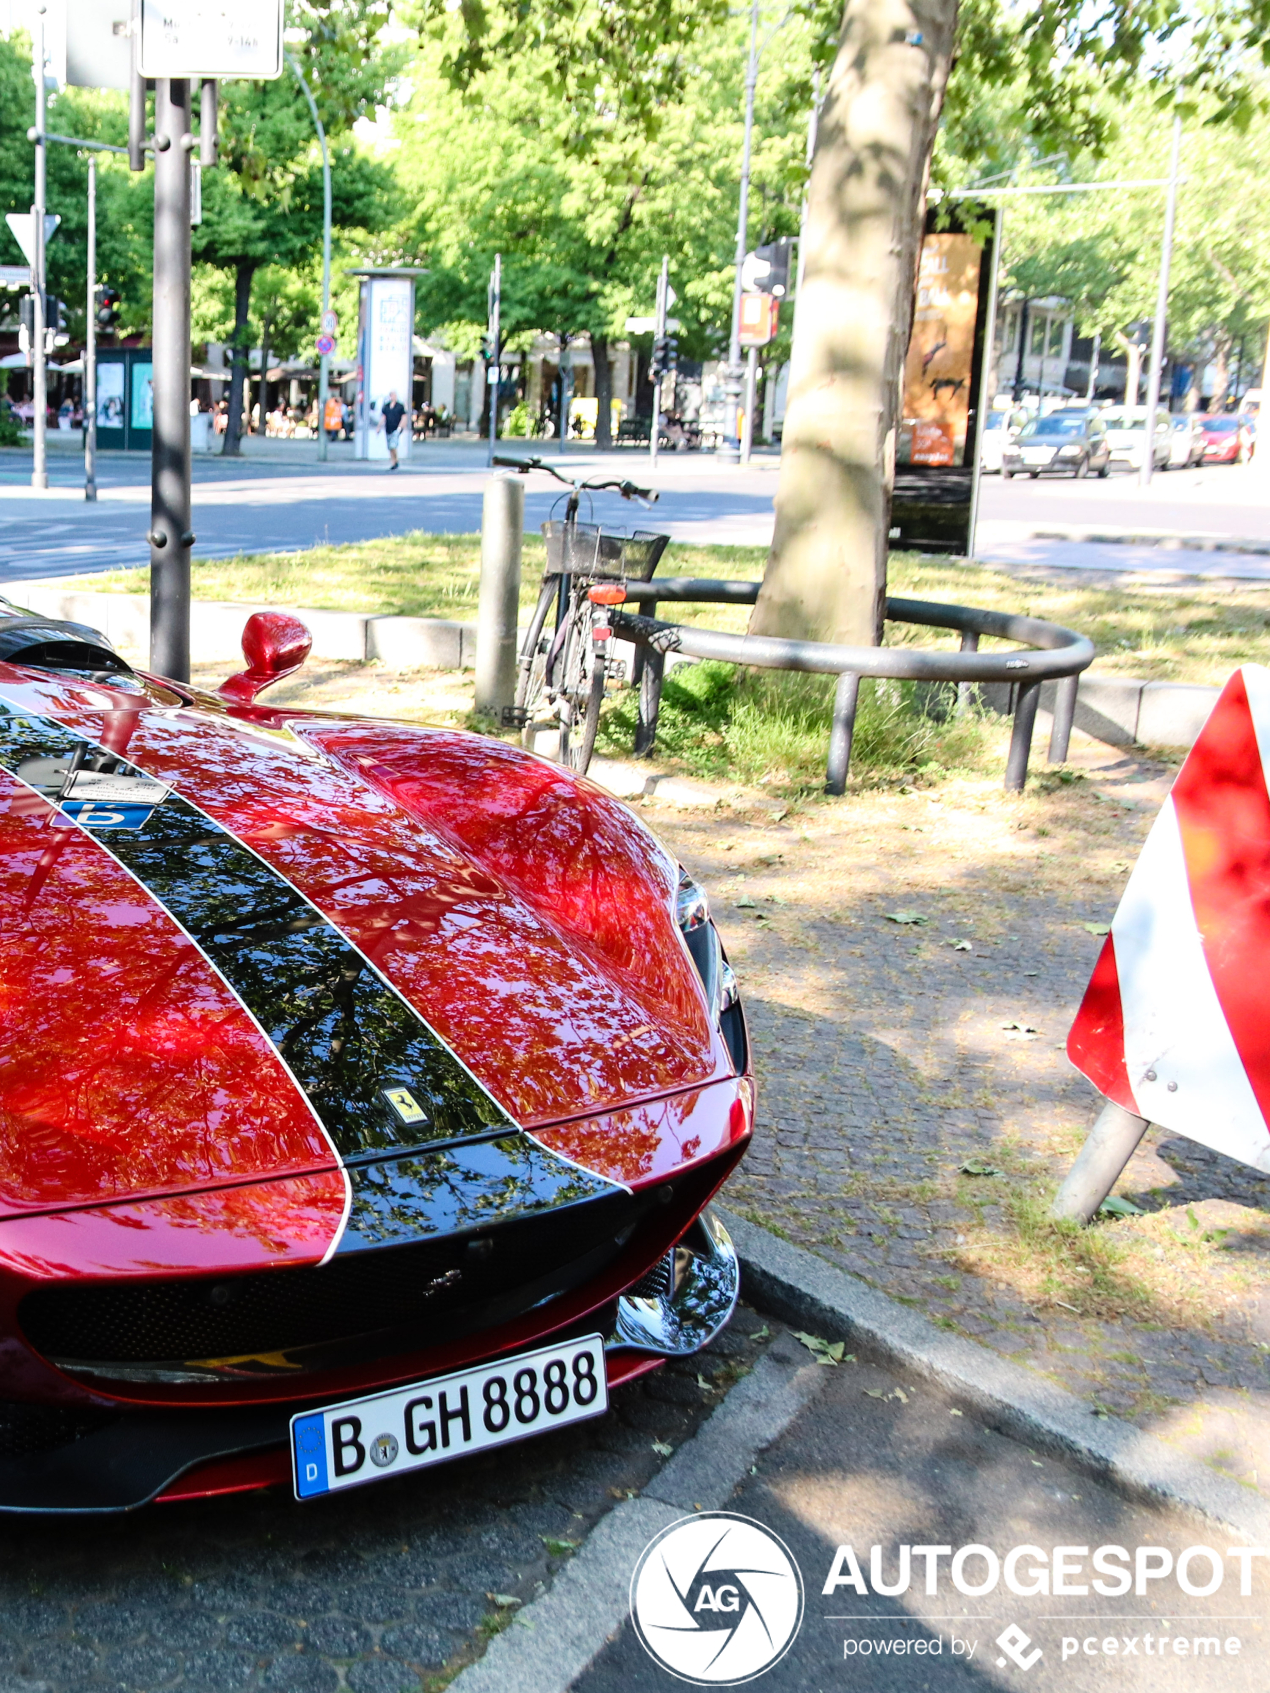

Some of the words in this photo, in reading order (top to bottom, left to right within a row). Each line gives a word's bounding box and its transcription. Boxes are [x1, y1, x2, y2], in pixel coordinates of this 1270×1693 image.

[307, 1463, 318, 1481] D
[331, 1415, 366, 1477] B
[403, 1385, 472, 1455] GH
[483, 1350, 598, 1432] 8888
